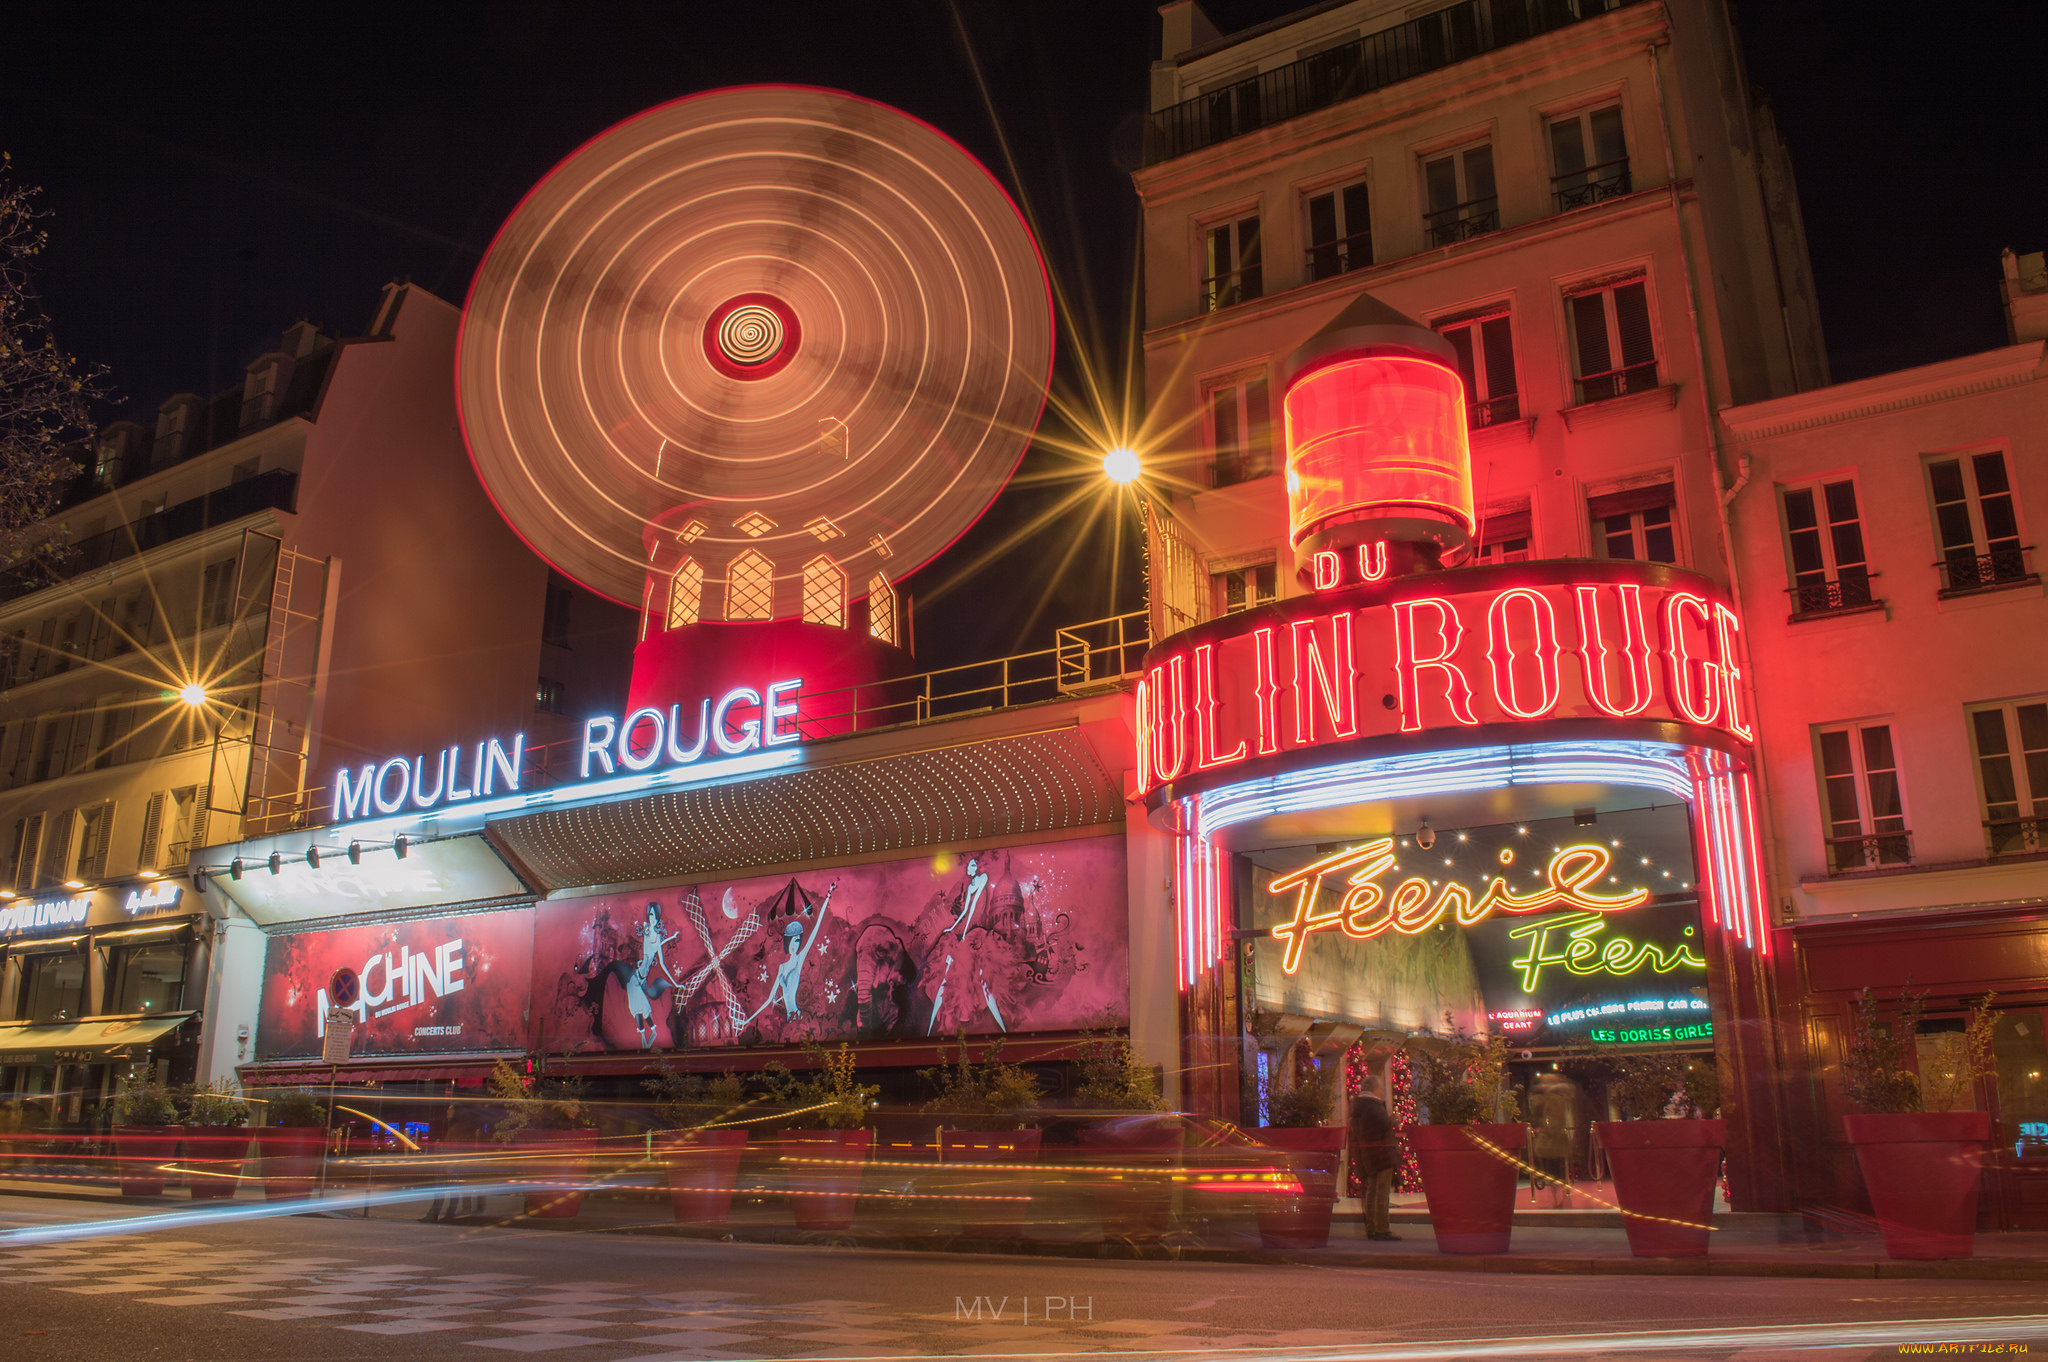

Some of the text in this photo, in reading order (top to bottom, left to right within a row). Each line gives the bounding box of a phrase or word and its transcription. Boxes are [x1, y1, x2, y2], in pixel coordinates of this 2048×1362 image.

[1313, 541, 1387, 590] DU
[1390, 583, 1753, 742] ROUGE
[332, 677, 804, 822] MOULIN ROUGE
[1268, 836, 1649, 975] Féerie
[414, 1025, 462, 1037] CONCERTS CLUB
[1591, 1022, 1713, 1042] LES DORISS GIRLS
